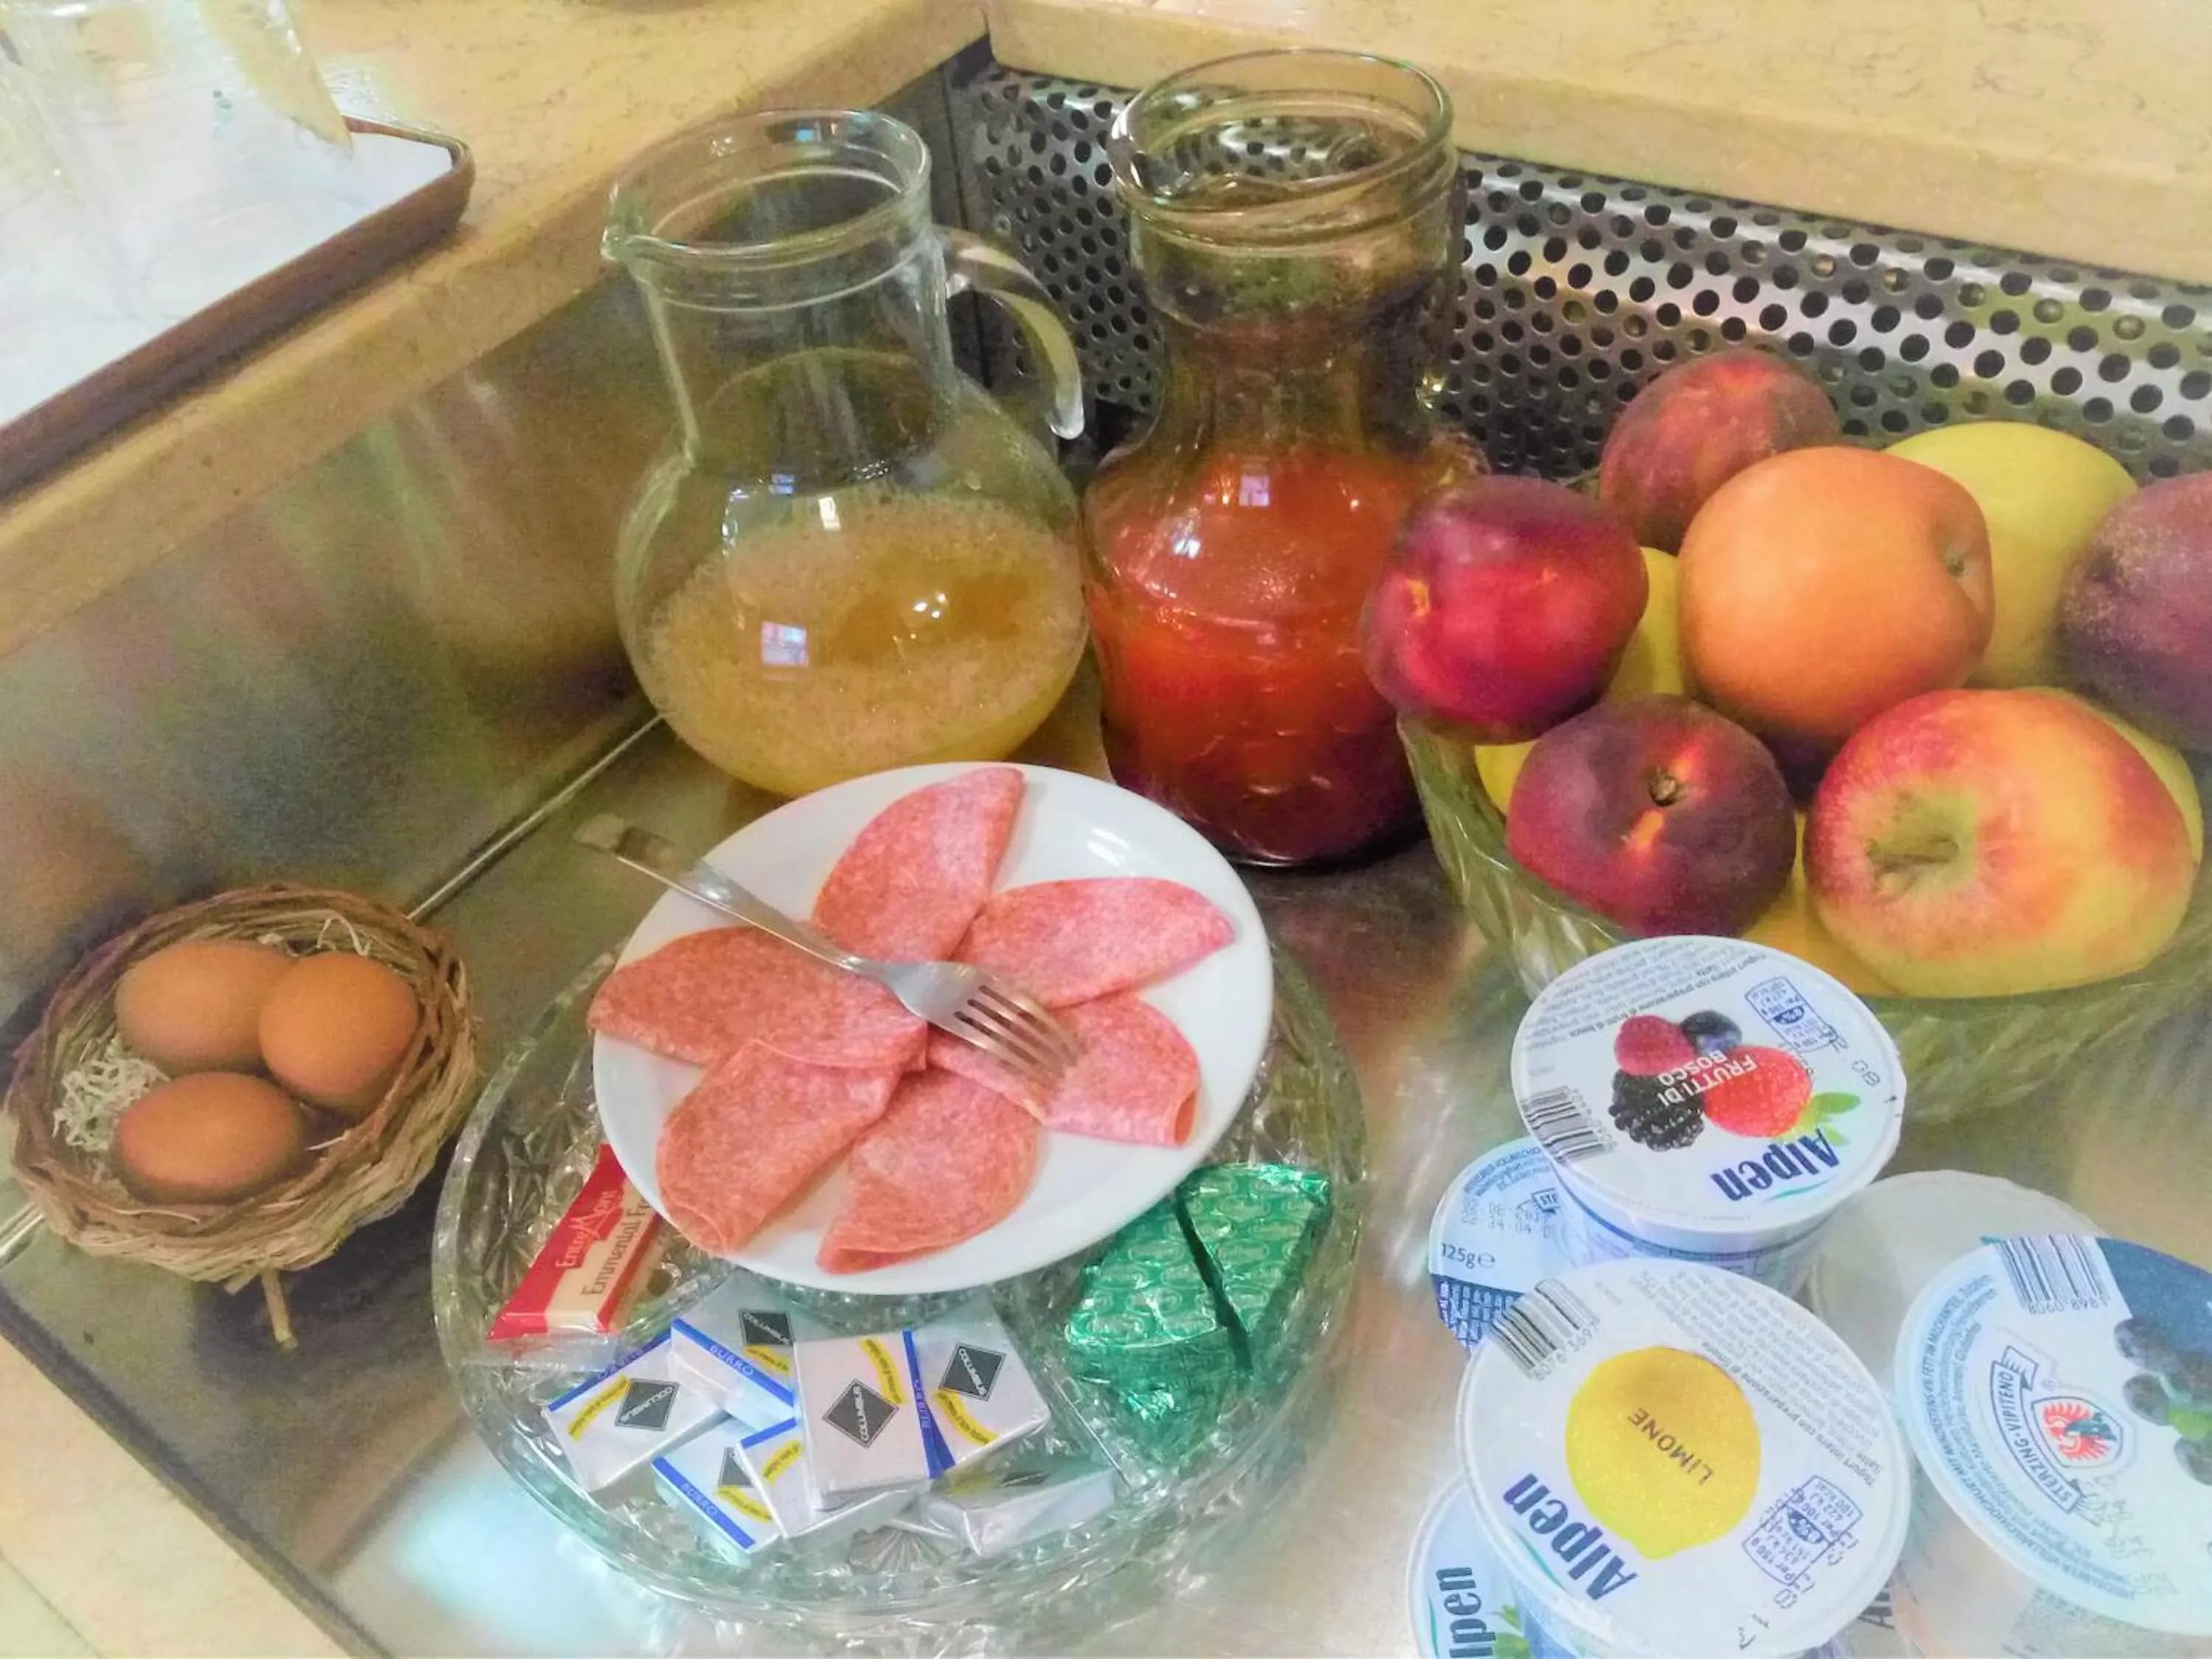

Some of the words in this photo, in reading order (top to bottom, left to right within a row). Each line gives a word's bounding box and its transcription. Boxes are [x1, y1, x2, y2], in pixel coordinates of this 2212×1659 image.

[1658, 1050, 1726, 1086] BOSCO
[1680, 1053, 1758, 1097] FRUTTI
[1710, 1127, 1840, 1201] Alpen
[580, 1219, 641, 1293] Emmental
[709, 1344, 754, 1376] BURRO
[959, 1348, 987, 1397] COLUMBUS
[621, 1386, 673, 1422] COLUMBUS
[852, 1385, 869, 1442] COLUMBUS
[1627, 1407, 1714, 1486] LIMONE
[1503, 1473, 1638, 1601] Alpen
[1436, 1567, 1497, 1659] lpen
